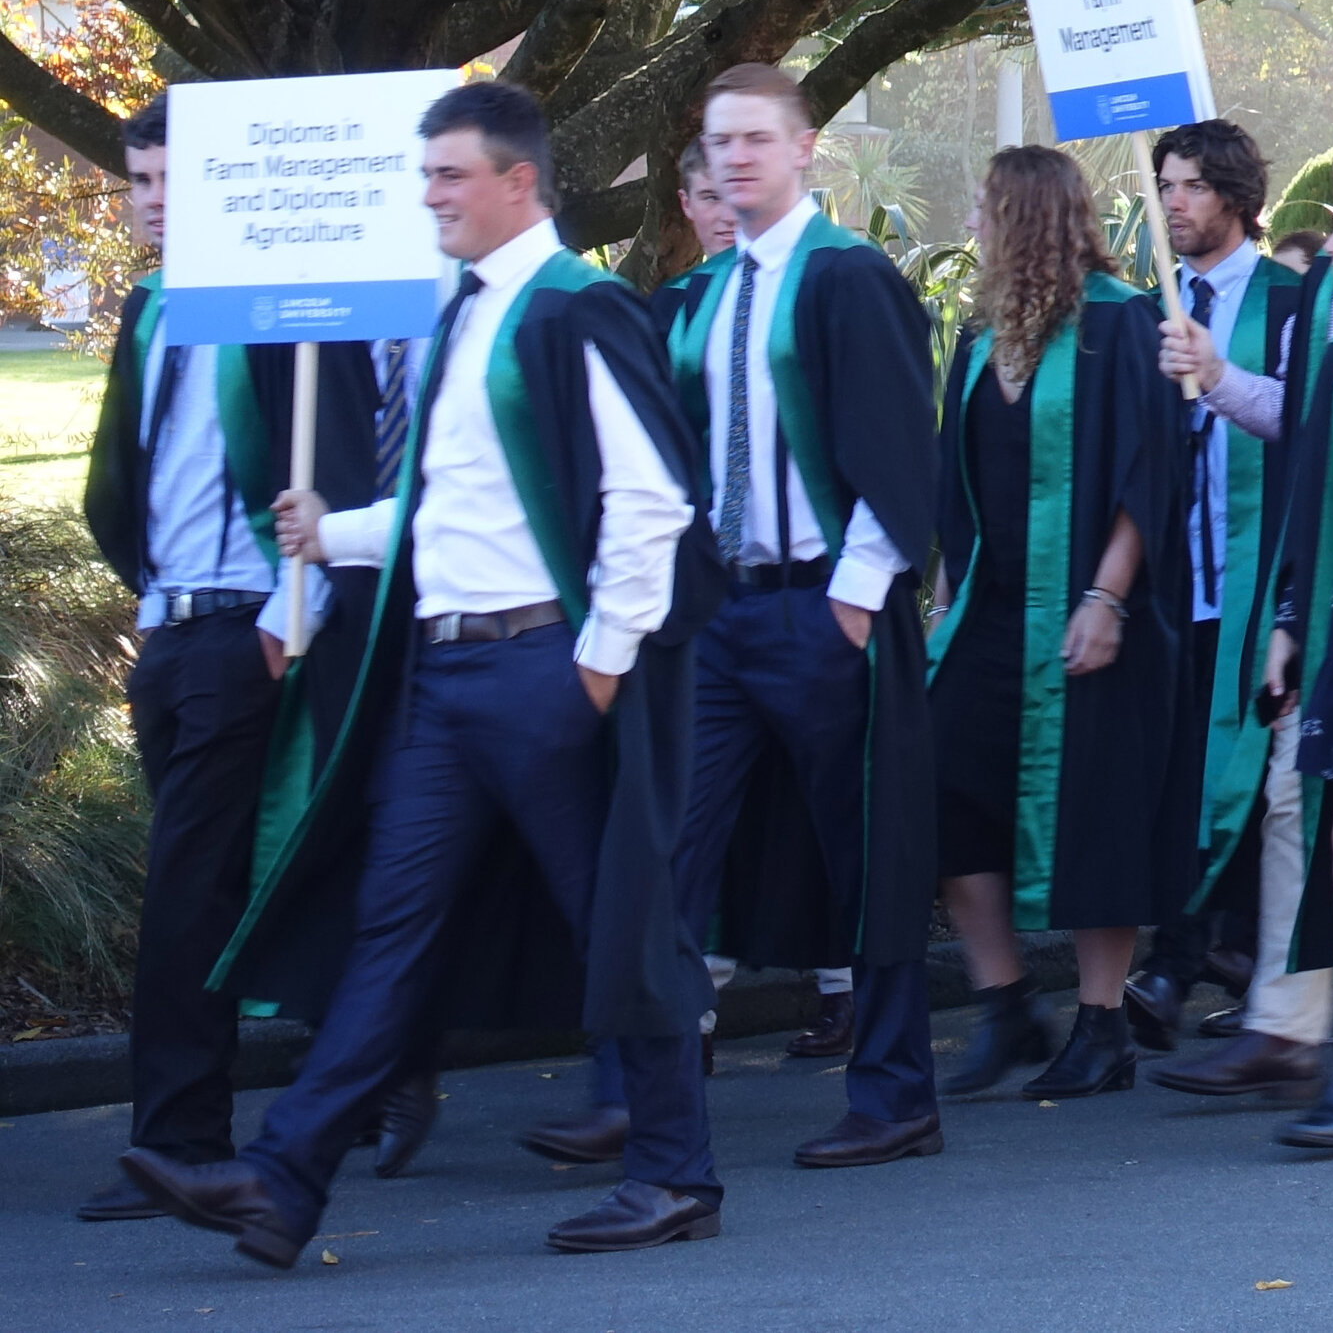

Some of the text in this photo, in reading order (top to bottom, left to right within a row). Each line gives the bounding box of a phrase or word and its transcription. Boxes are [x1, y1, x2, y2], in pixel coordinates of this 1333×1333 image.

[1059, 16, 1157, 53] Management
[248, 117, 364, 150] Diploma in
[203, 151, 407, 180] Farm Management
[222, 182, 385, 215] and Diploma in
[240, 218, 365, 251] Agriculture
